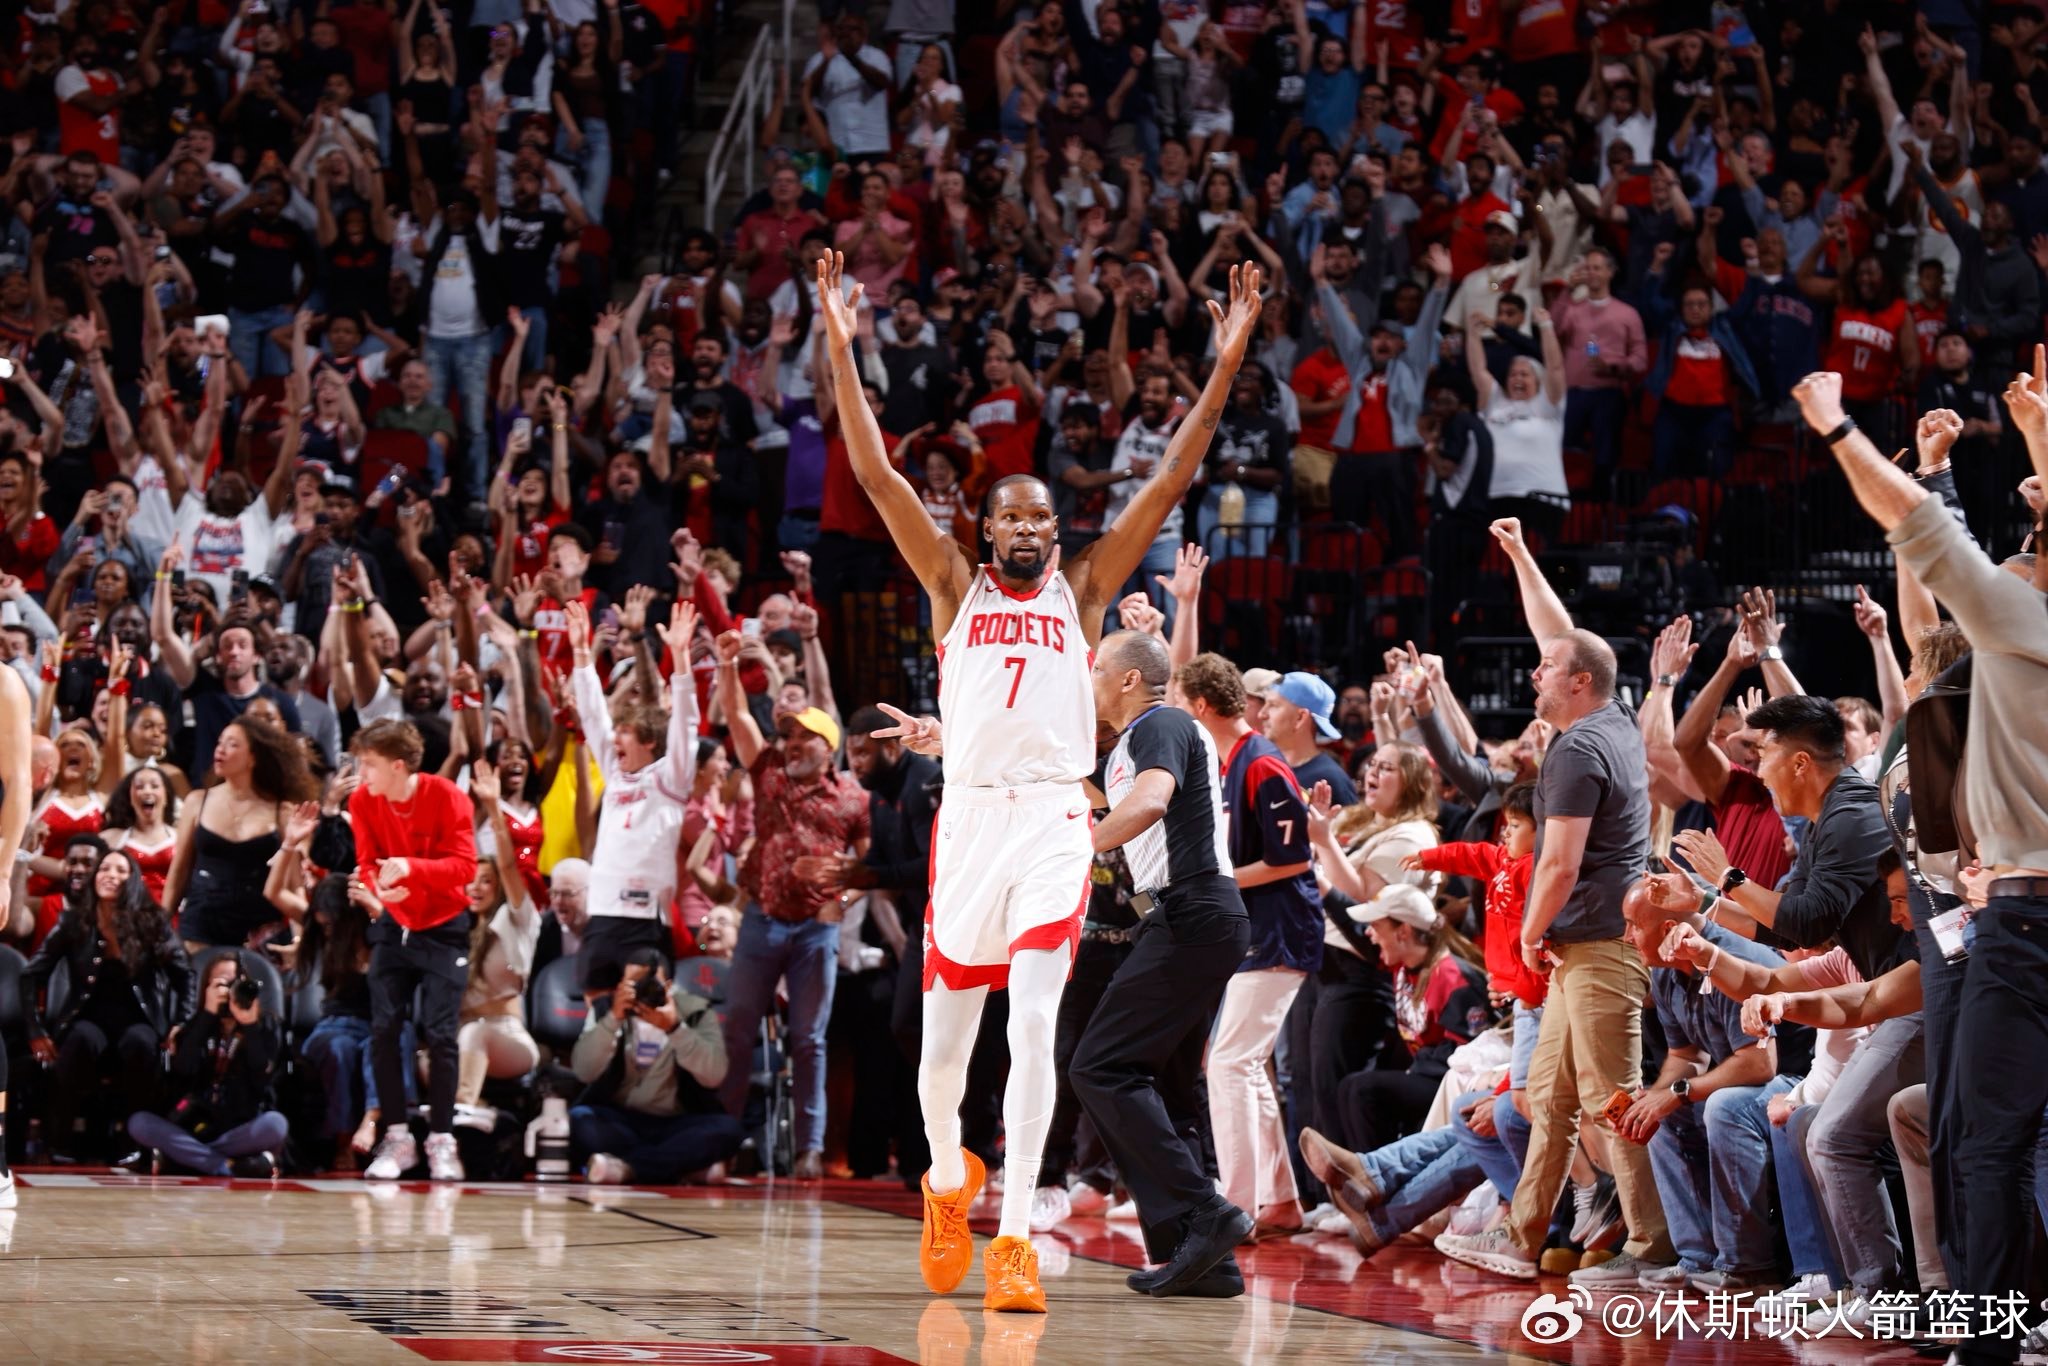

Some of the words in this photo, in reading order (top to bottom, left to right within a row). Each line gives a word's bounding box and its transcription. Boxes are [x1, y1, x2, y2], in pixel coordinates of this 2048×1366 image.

[545, 630, 562, 661] 7
[966, 609, 1066, 654] ROCKETS
[1003, 656, 1028, 709] 7
[1276, 818, 1294, 846] 7
